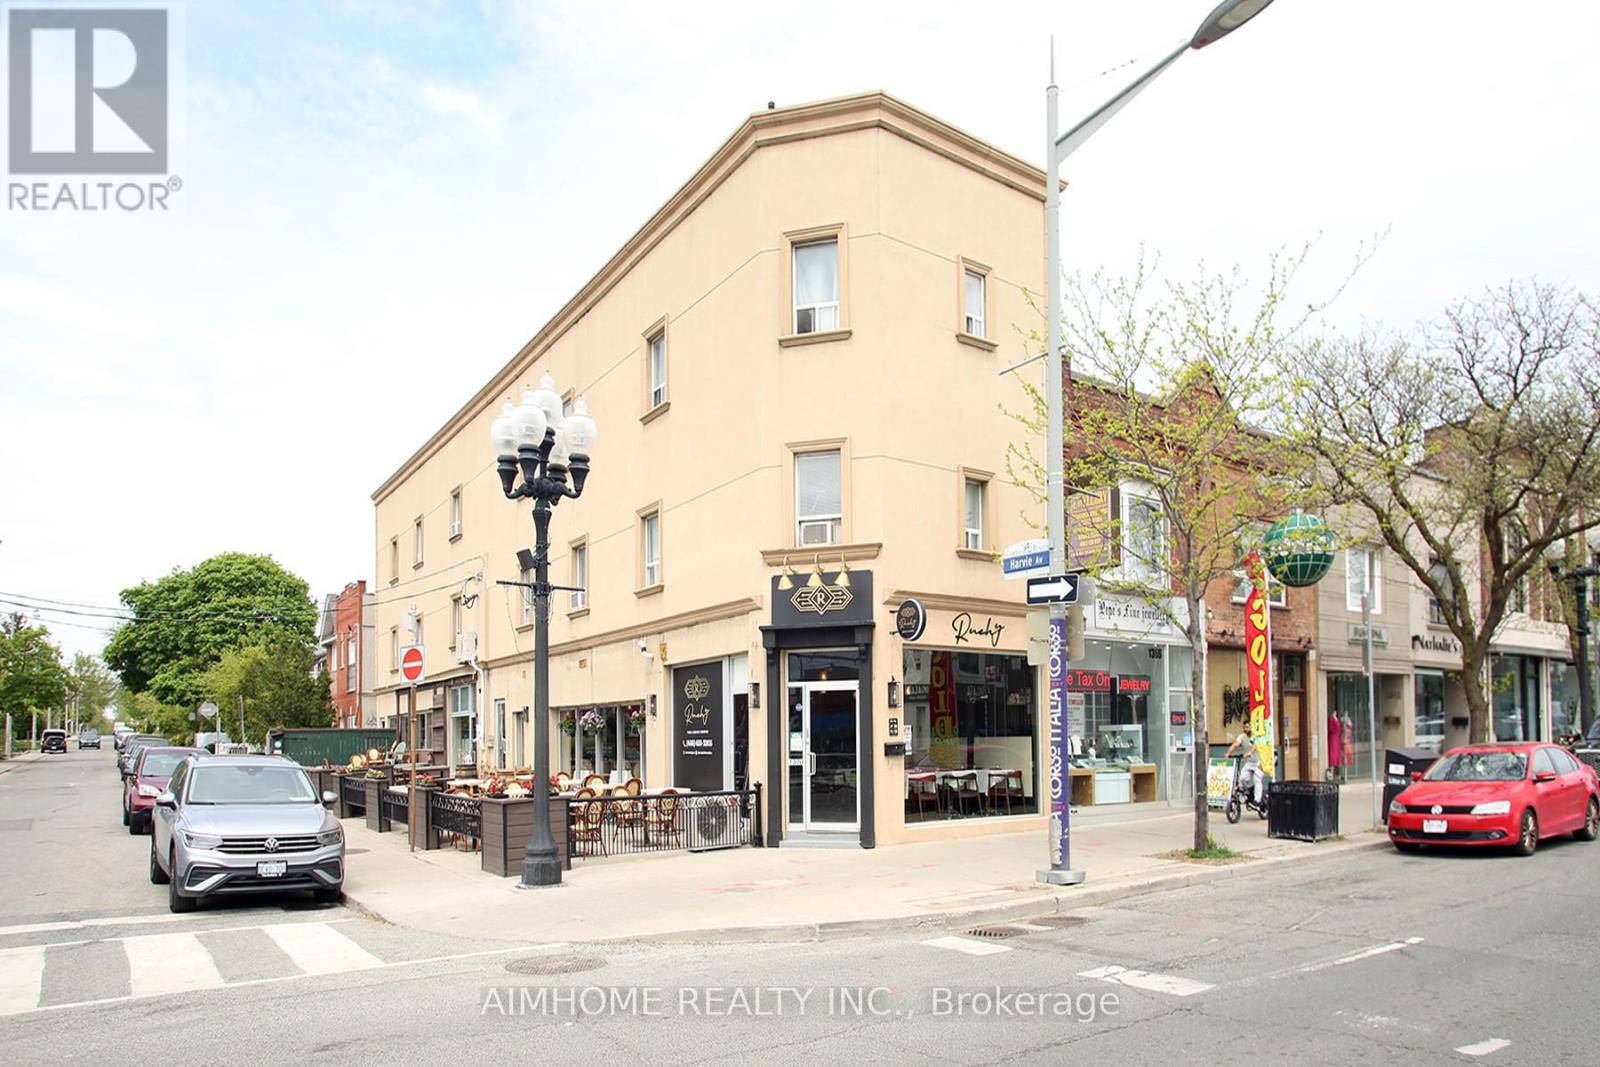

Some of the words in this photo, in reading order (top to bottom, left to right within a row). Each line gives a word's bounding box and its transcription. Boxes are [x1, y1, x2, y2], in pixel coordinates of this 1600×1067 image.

[1010, 555, 1033, 569] Harvie
[817, 592, 826, 605] R
[1098, 600, 1122, 619] Pepe's
[1123, 604, 1141, 618] Fine
[1049, 624, 1061, 677] CORSO
[1076, 671, 1094, 687] Tax
[1120, 679, 1151, 691] JEWELRY
[1050, 688, 1062, 741] ITALIA
[1050, 745, 1062, 799] CORSO
